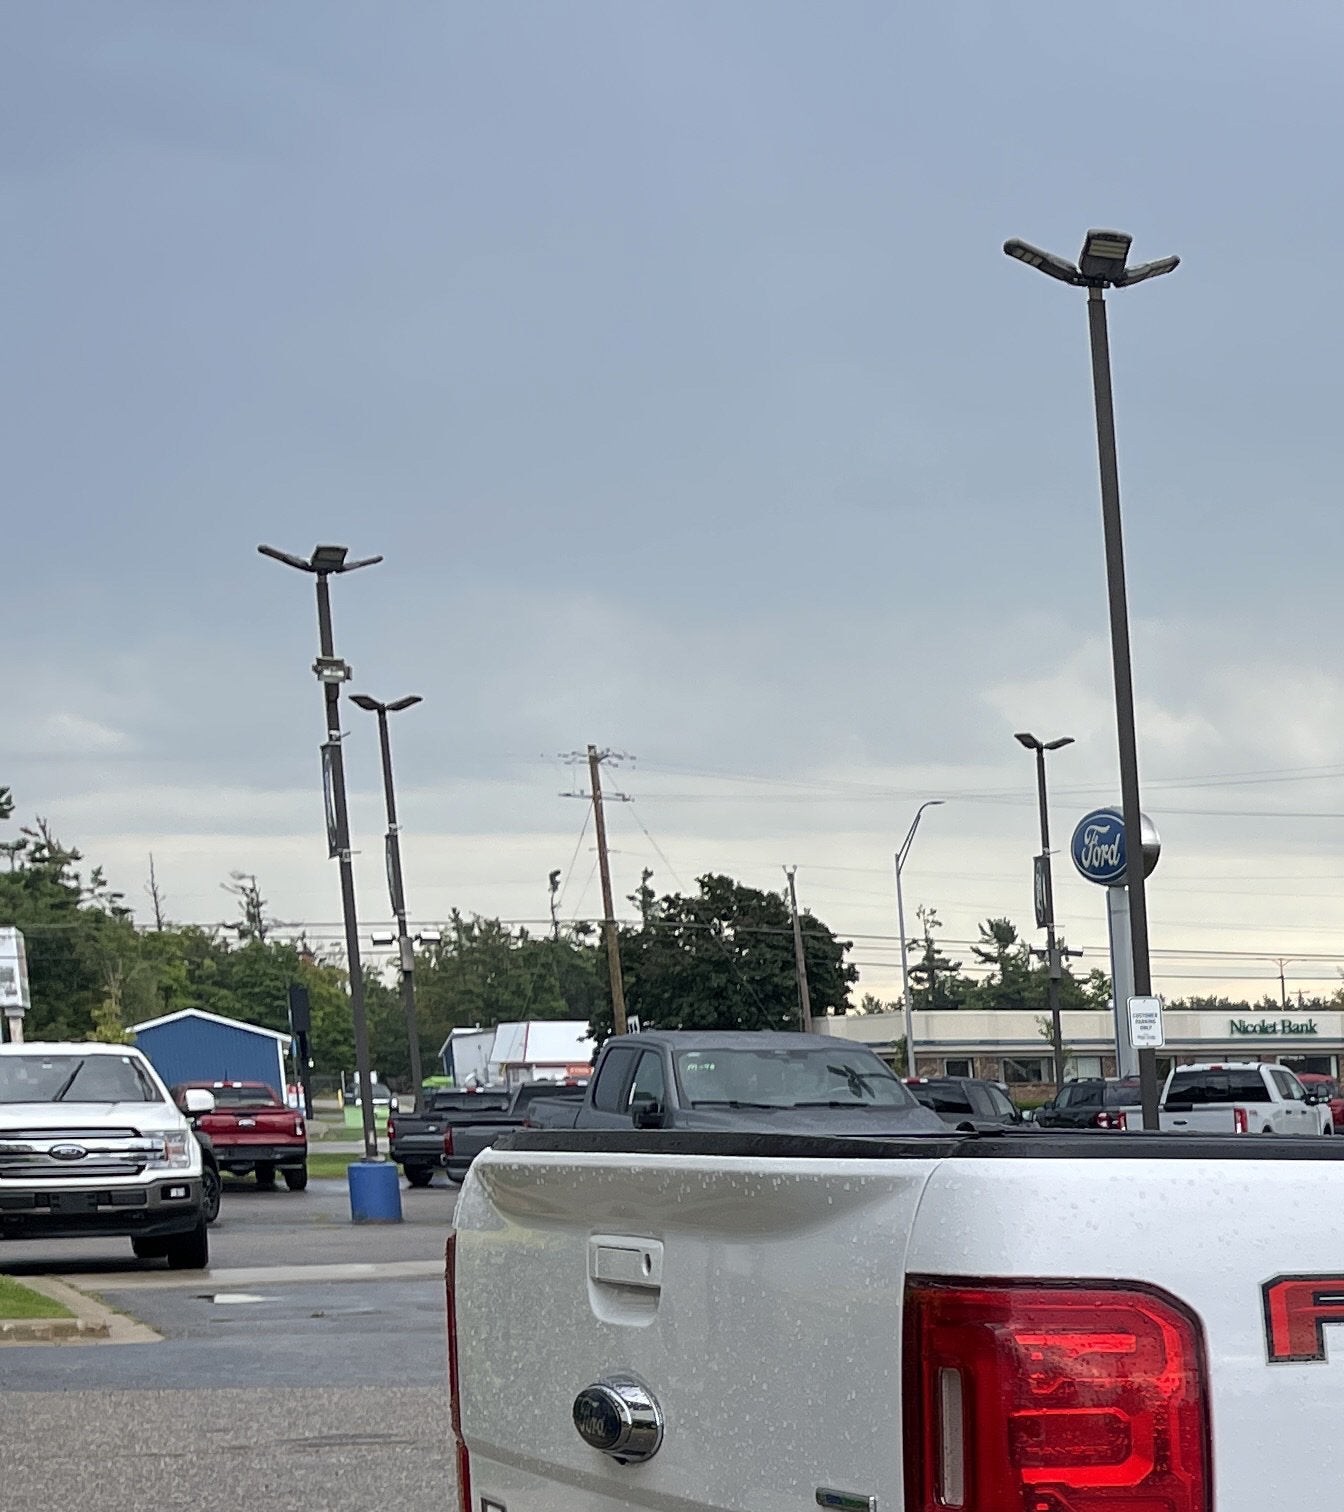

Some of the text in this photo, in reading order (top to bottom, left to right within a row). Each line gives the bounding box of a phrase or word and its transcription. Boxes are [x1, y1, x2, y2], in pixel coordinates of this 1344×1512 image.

[1081, 824, 1121, 868] Ford
[1230, 1018, 1318, 1035] Nicolet Bank
[578, 1396, 608, 1438] Ford
